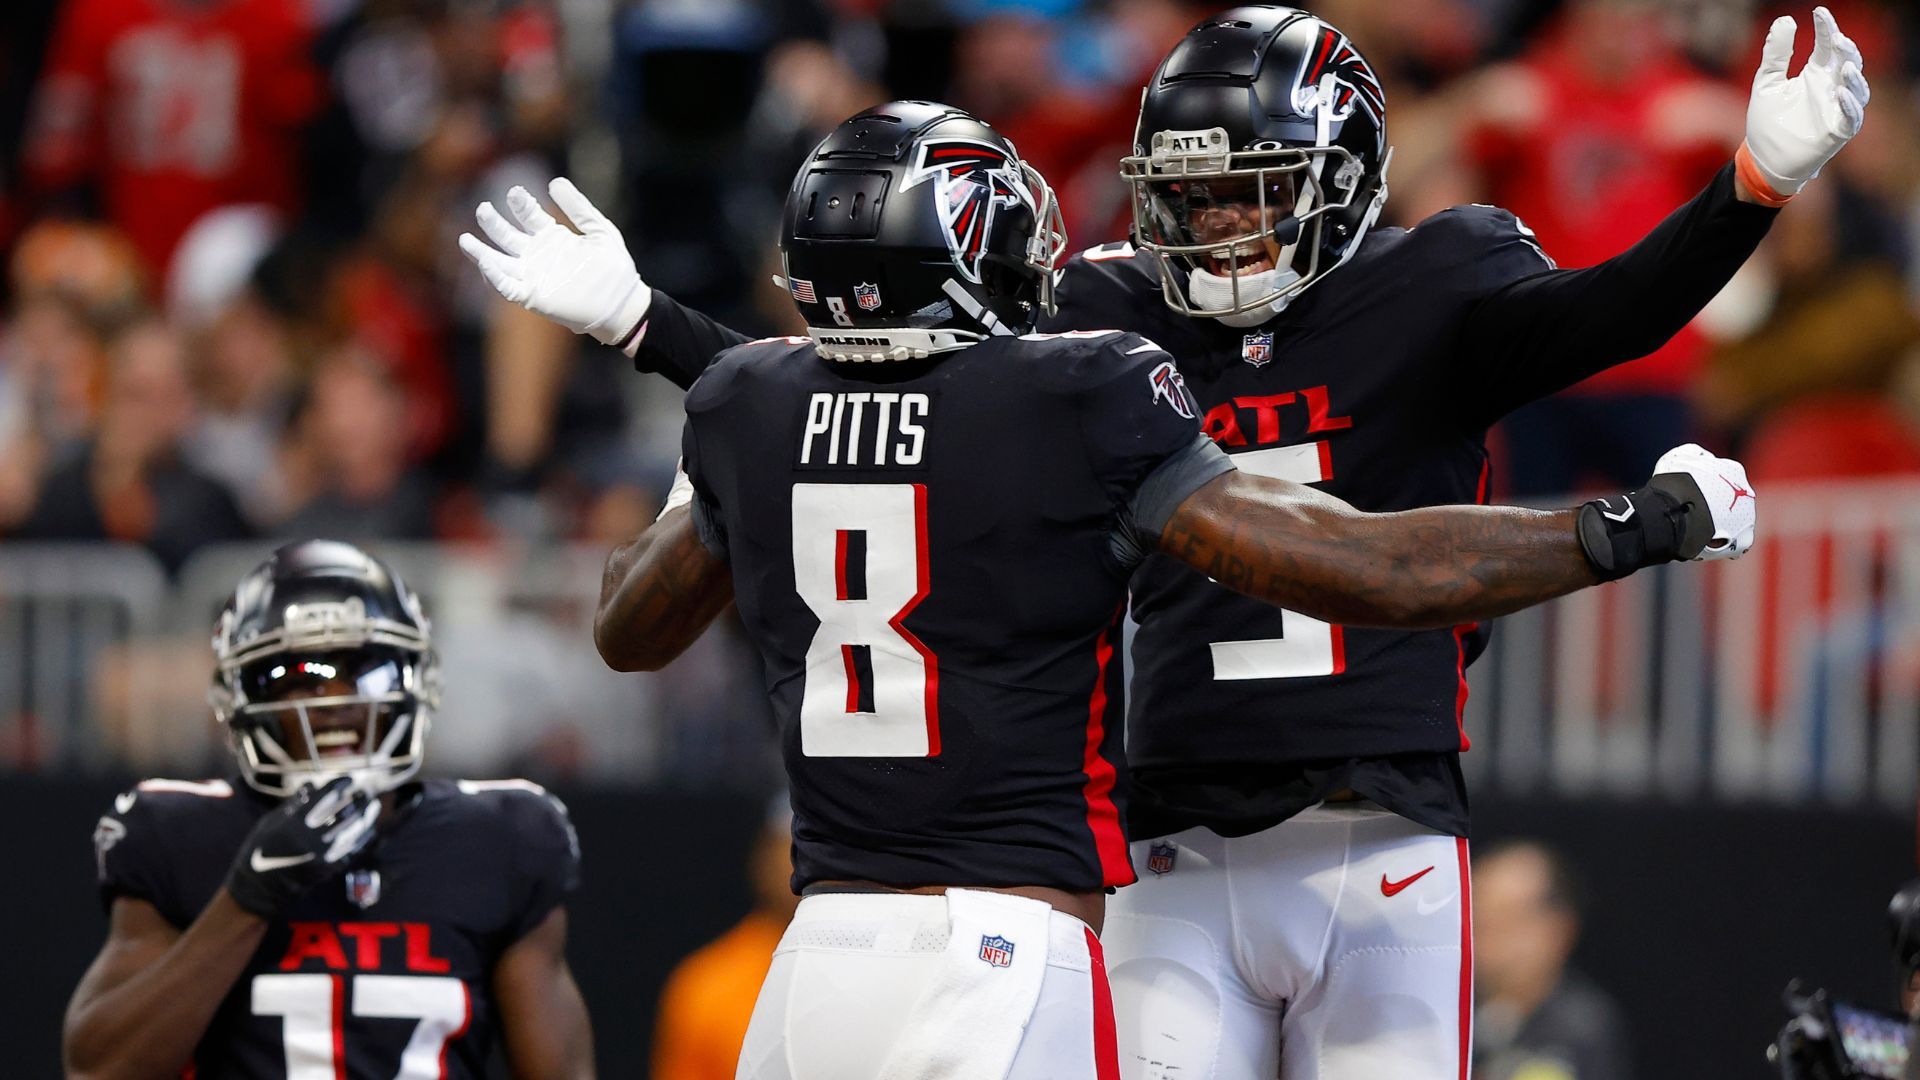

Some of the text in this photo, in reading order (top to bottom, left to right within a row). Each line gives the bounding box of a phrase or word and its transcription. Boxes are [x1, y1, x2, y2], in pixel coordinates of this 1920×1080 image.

[1172, 136, 1208, 151] ATL
[825, 296, 854, 327] 8
[800, 392, 929, 466] PITTS
[1201, 385, 1353, 447] ATL
[791, 483, 942, 758] 8
[278, 921, 451, 973] ATL
[982, 946, 1009, 966] NFL
[251, 973, 472, 1080] 17
